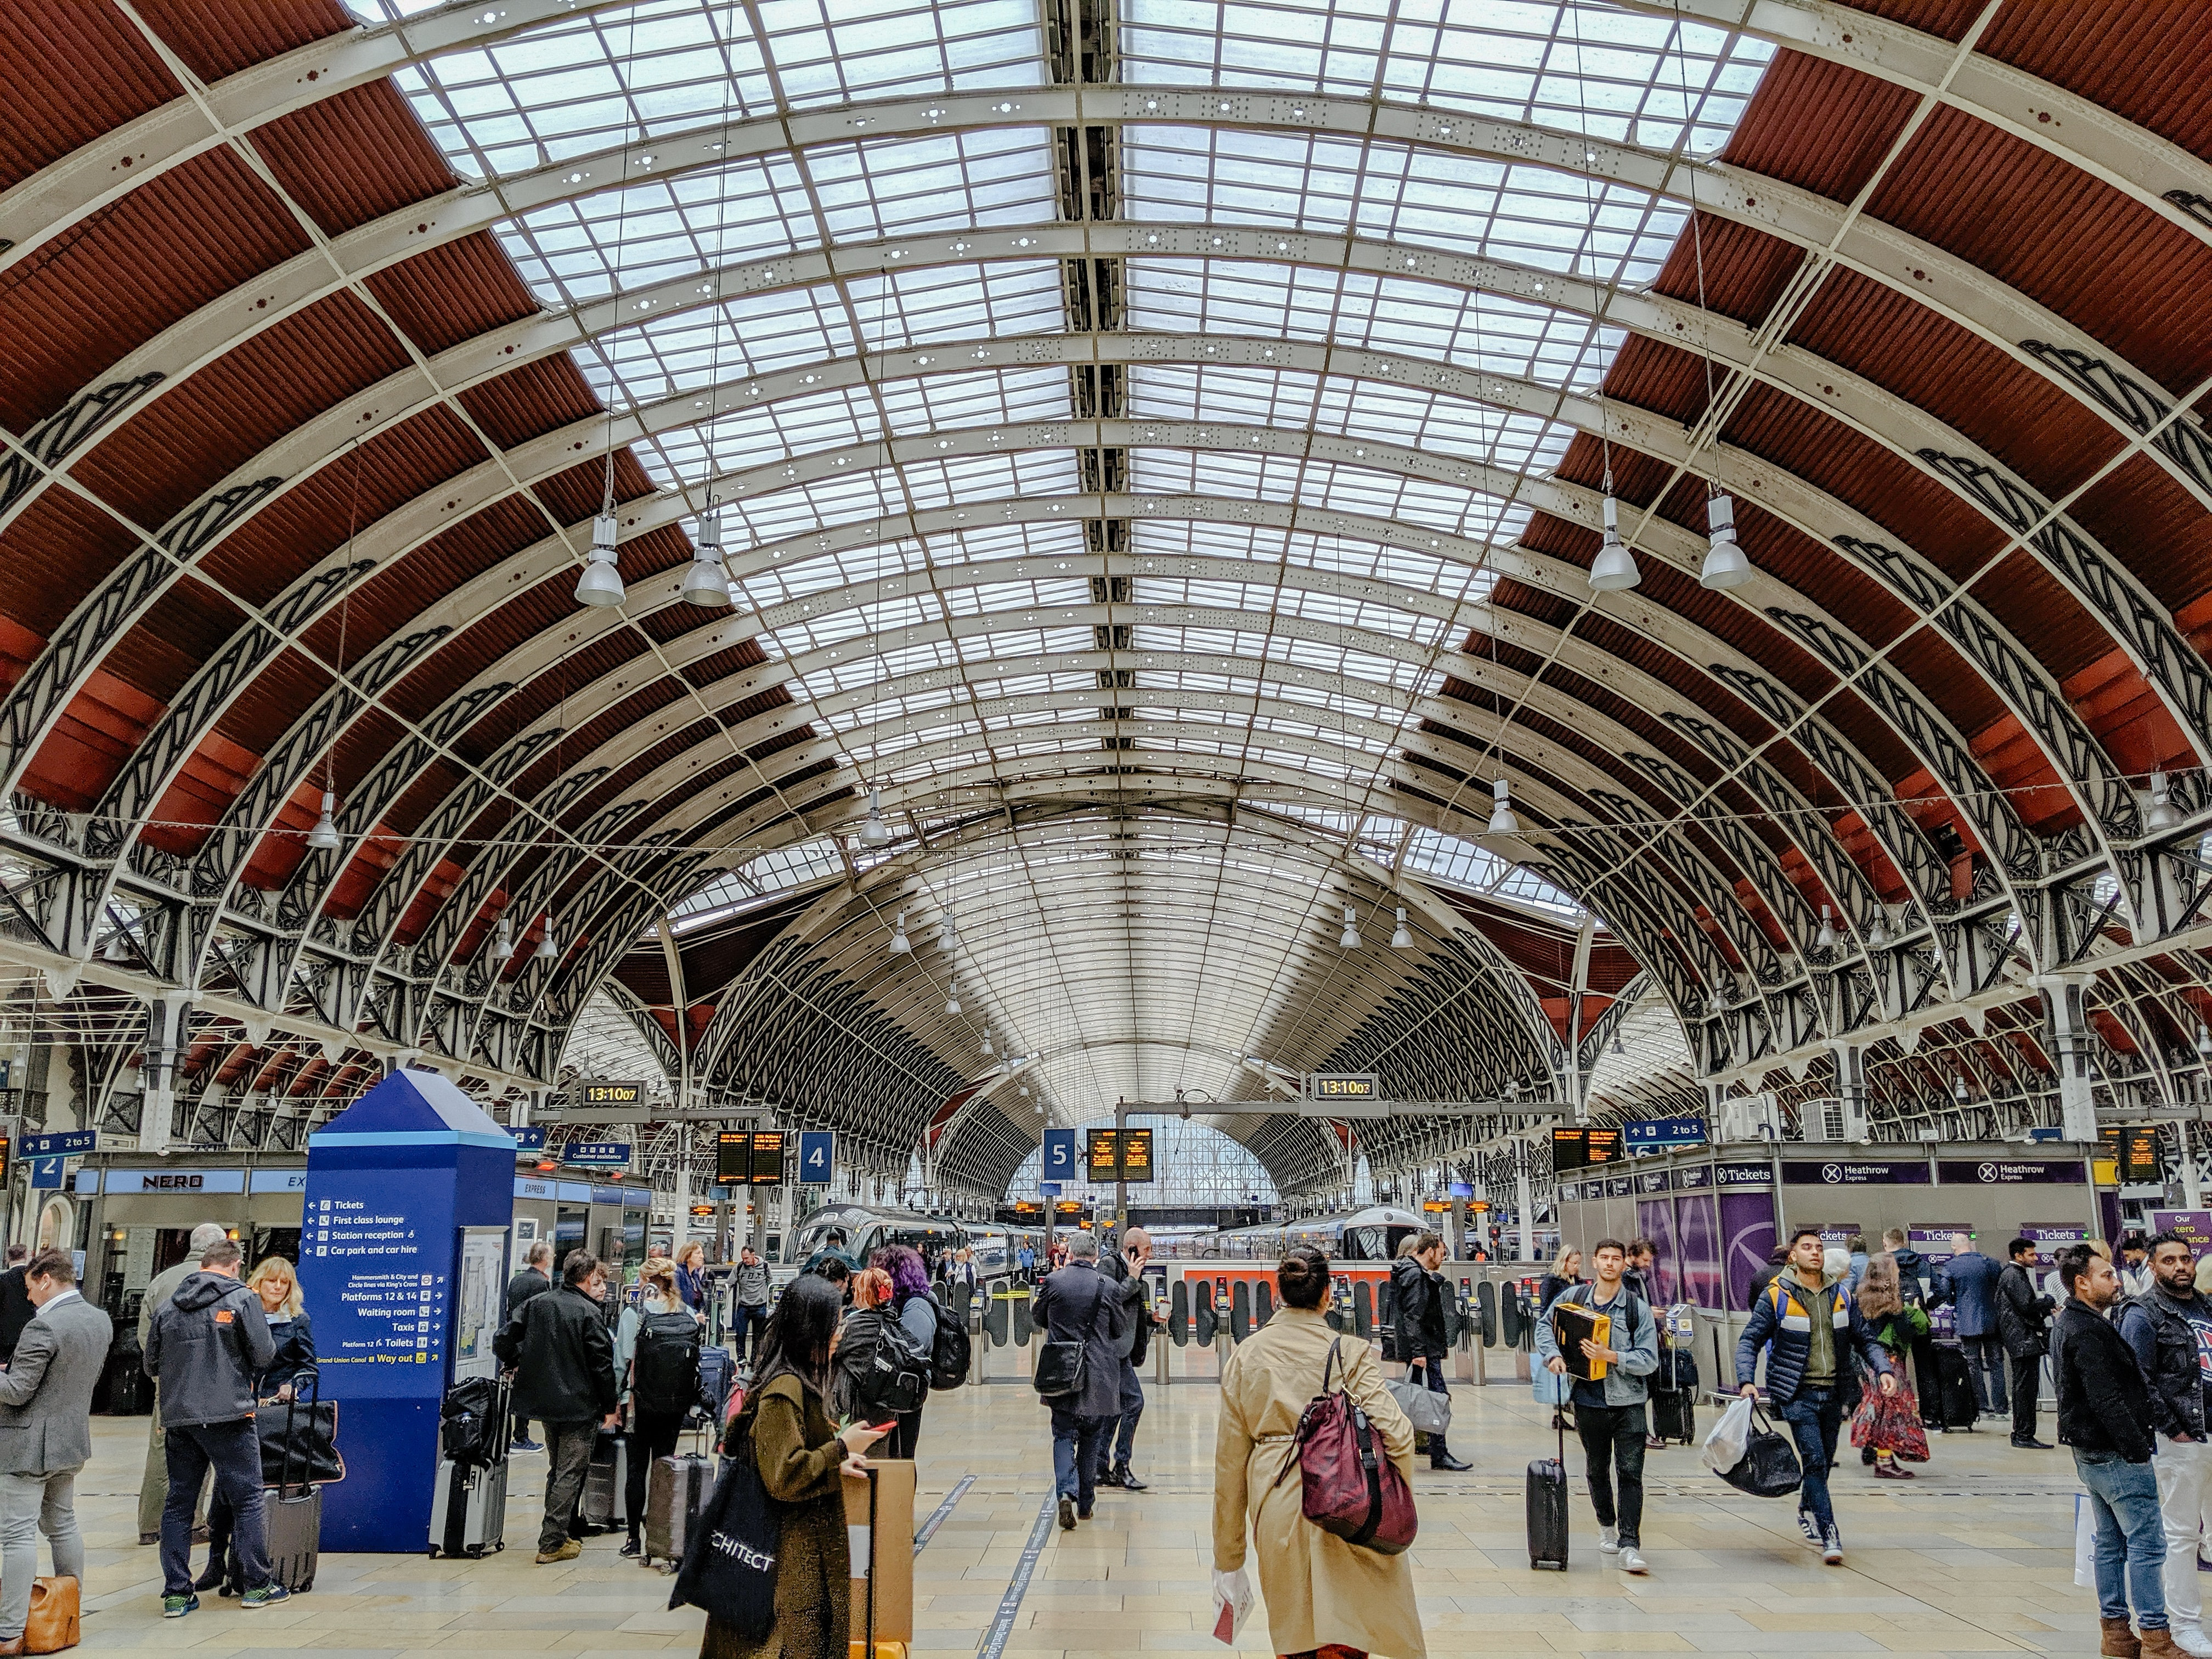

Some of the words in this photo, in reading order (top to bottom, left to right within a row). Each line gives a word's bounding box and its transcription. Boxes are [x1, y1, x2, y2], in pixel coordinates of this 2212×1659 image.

[1672, 1126, 1679, 1135] 2
[1680, 1126, 1690, 1134] to
[1691, 1125, 1698, 1133] 5
[65, 1138, 72, 1147] 2
[83, 1136, 90, 1145] 5
[808, 1147, 824, 1168] 4
[1052, 1144, 1067, 1165] 5
[42, 1158, 57, 1174] 2
[1844, 1165, 1889, 1174] Heathrow
[2000, 1165, 2045, 1173] Heathrow
[1728, 1169, 1771, 1181] Tickets
[1845, 1174, 1867, 1182] Express
[143, 1175, 204, 1189] NERO
[524, 1184, 546, 1194] EXPRESS
[334, 1201, 364, 1209] Tickets
[333, 1216, 352, 1224] First
[353, 1216, 373, 1224] class
[375, 1216, 404, 1225] lounge
[332, 1231, 363, 1240] Station
[364, 1231, 404, 1240] reception
[1820, 1231, 1847, 1241] ckets
[1923, 1230, 1955, 1240] Ticke
[2036, 1229, 2076, 1240] Tickets
[331, 1246, 346, 1255] Car
[347, 1246, 366, 1256] park
[368, 1246, 383, 1254] and
[400, 1245, 417, 1254] hire
[341, 1292, 382, 1301] Platforms
[385, 1292, 396, 1301] 12
[397, 1292, 404, 1300] &
[406, 1291, 417, 1300] 14
[357, 1308, 392, 1318] Waiting
[392, 1323, 415, 1332] Taxis
[385, 1338, 414, 1347] Toilets
[377, 1354, 397, 1363] Way
[397, 1355, 413, 1363] out
[711, 1530, 776, 1573] CHITECT
